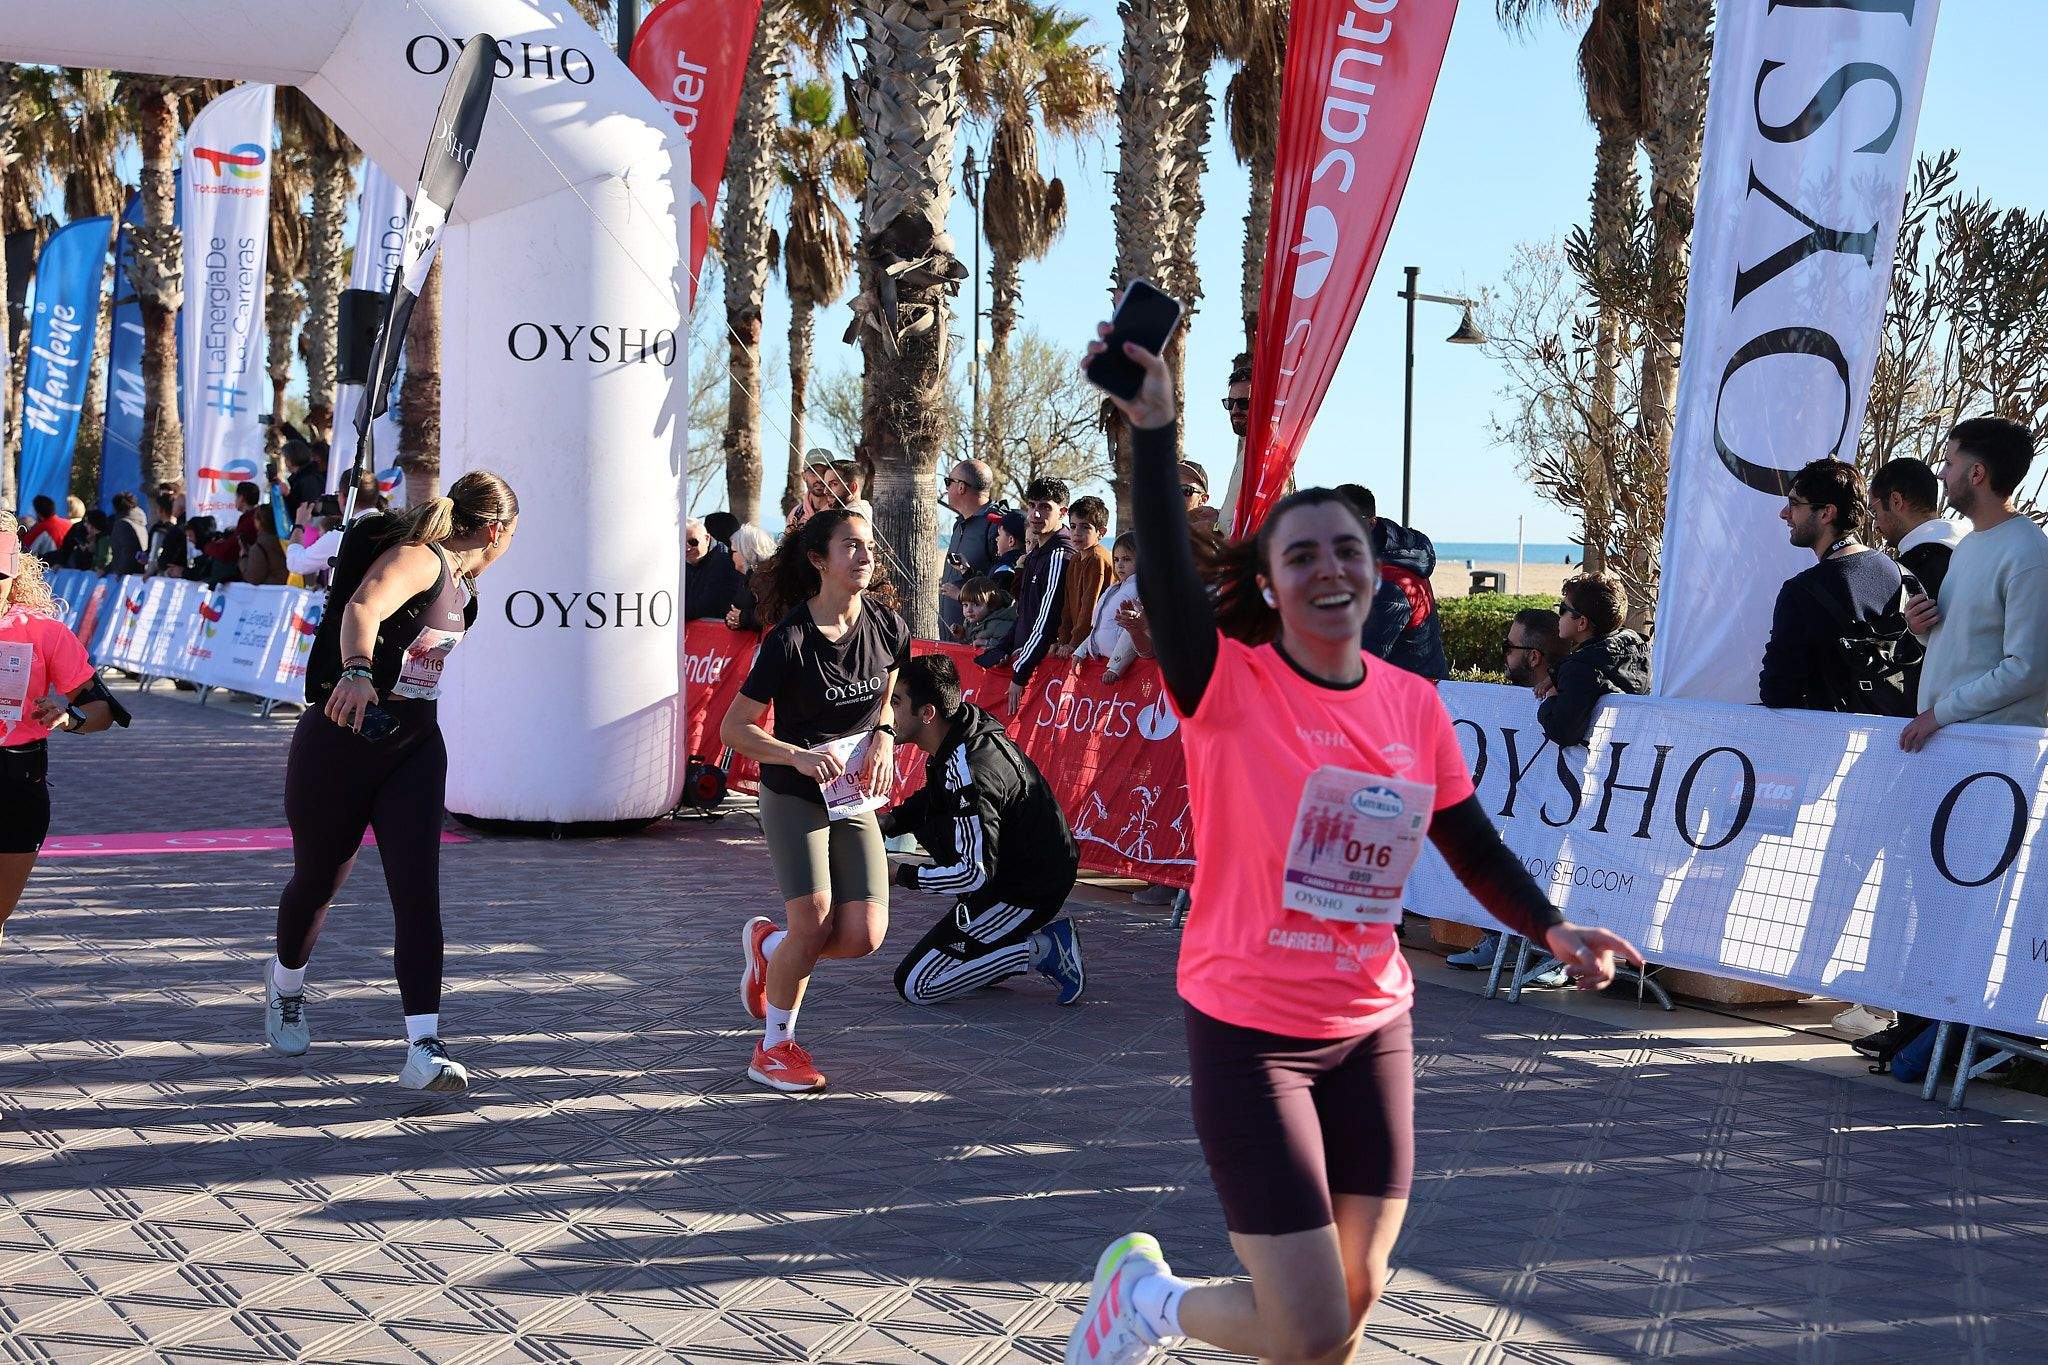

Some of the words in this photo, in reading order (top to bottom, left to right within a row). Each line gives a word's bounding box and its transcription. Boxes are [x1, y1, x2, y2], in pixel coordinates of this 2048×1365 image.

[405, 35, 595, 85] OSHO
[1714, 0, 1915, 497] OYS
[508, 322, 676, 367] OYSHO
[24, 304, 82, 436] Marlene
[505, 590, 672, 629] OYSHO
[423, 658, 444, 672] 016
[825, 677, 881, 701] OYSHO
[1037, 678, 1136, 741] Sports
[1345, 840, 1392, 867] 016
[1295, 890, 1342, 910] OYSHO
[1268, 929, 1333, 953] CARRERA
